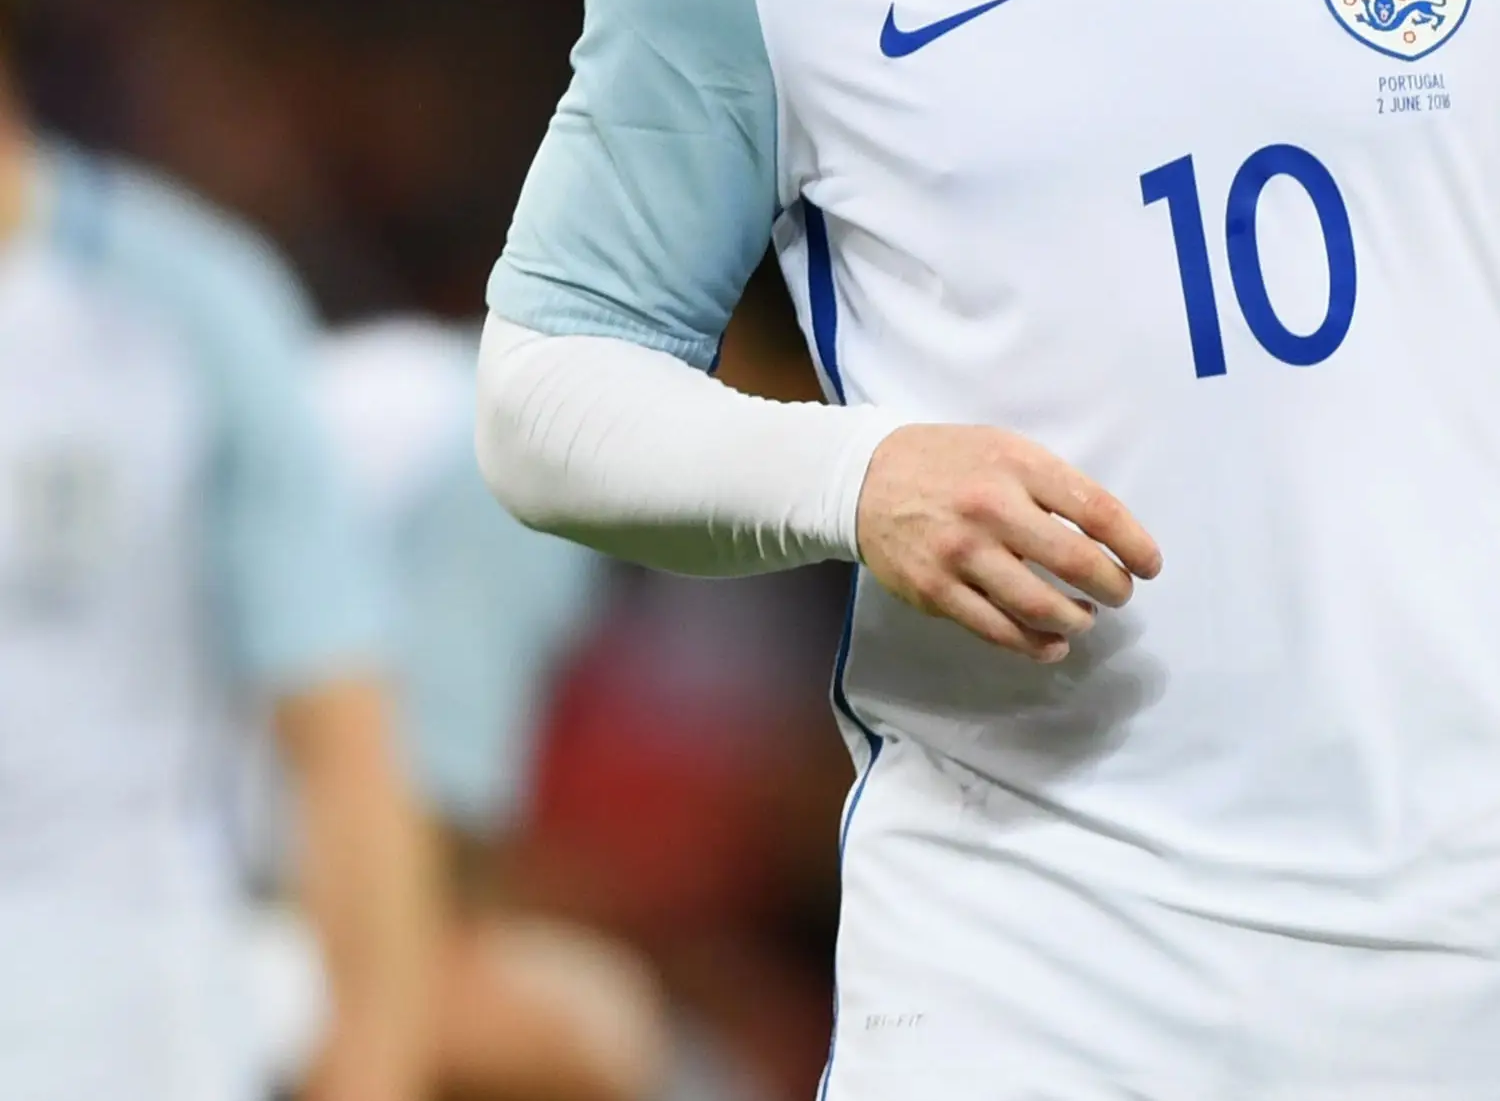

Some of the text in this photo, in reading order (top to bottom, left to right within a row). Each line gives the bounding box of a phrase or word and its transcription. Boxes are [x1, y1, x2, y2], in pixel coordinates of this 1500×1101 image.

[1378, 73, 1445, 92] PORTUGAL
[1376, 97, 1385, 114] 2
[1390, 95, 1421, 112] JUNE
[1139, 143, 1357, 379] 10
